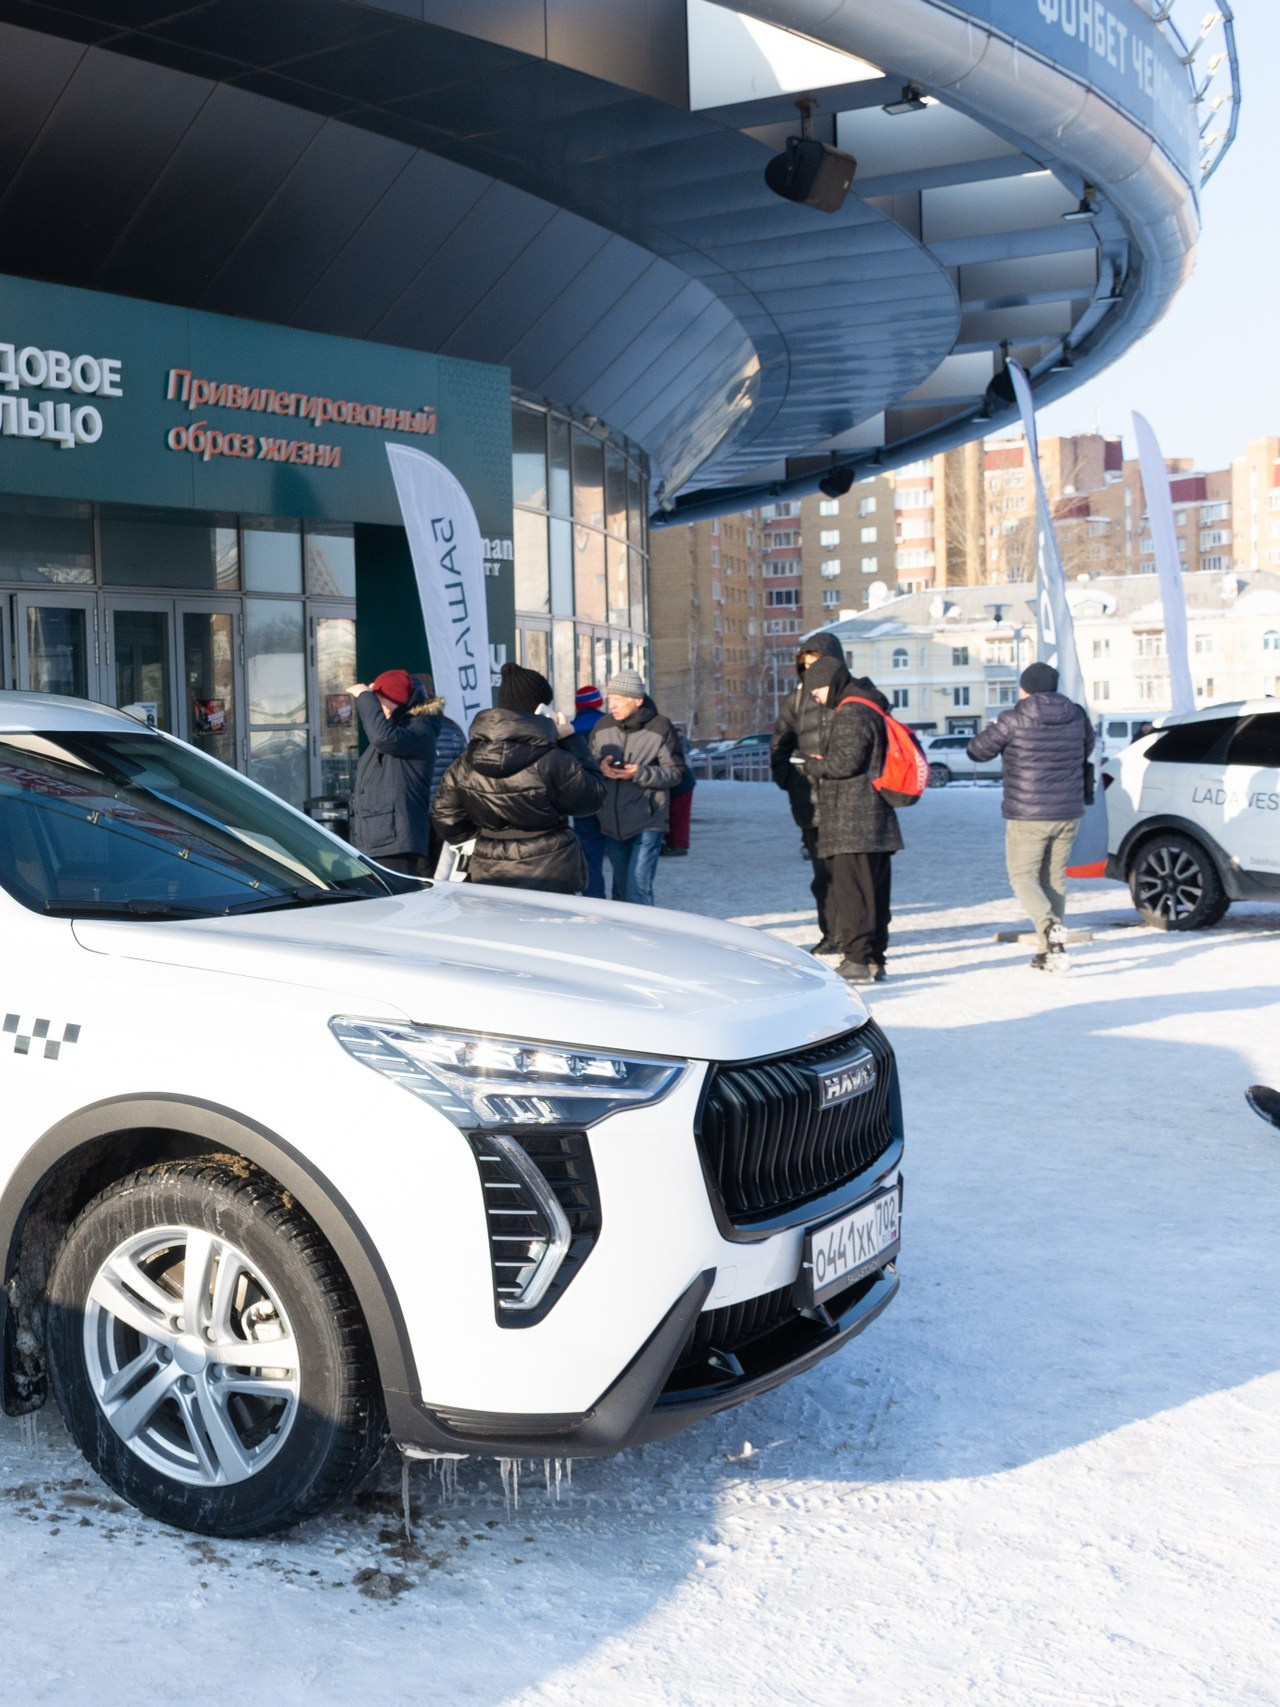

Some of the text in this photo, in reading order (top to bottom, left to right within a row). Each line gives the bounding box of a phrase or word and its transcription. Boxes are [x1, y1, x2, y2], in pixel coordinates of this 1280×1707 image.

[167, 369, 437, 435] Привилегированный
[168, 421, 342, 468] образ жизни
[876, 1196, 896, 1235] 702
